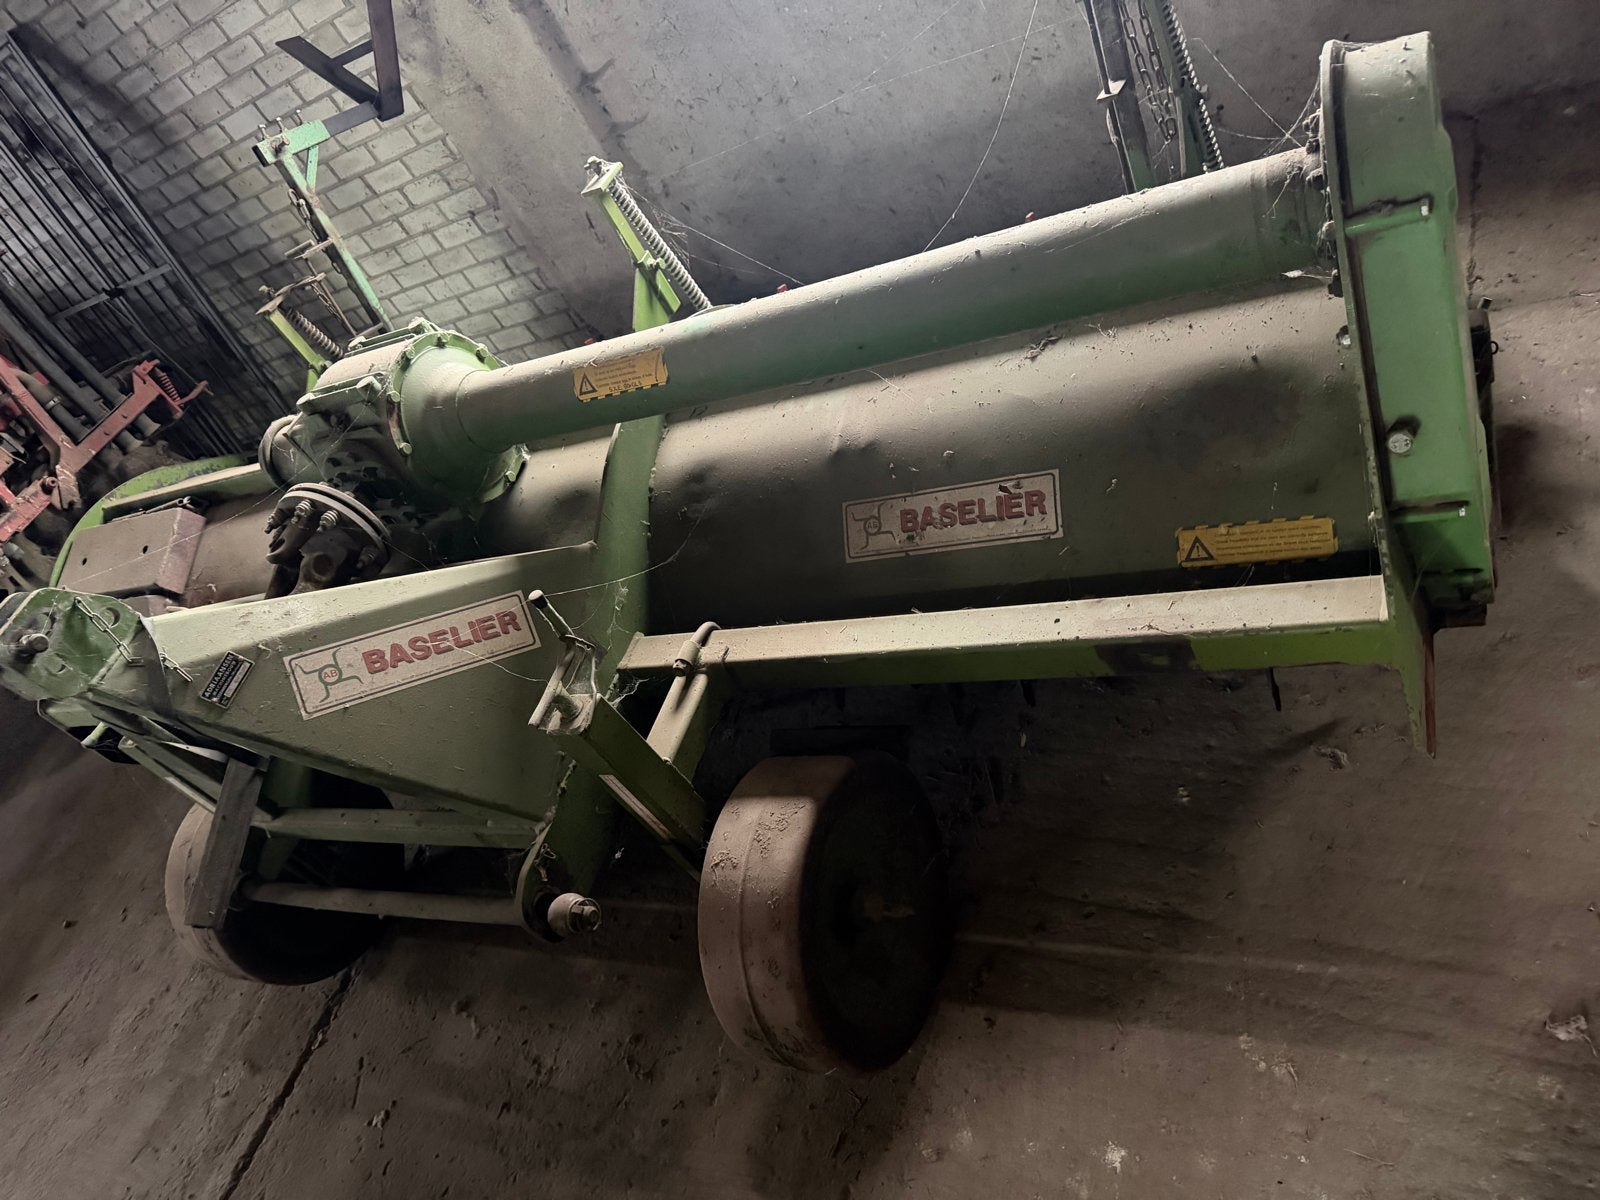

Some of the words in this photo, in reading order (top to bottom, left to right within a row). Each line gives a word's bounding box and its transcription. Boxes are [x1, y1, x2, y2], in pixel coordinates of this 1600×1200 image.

[900, 489, 1048, 534] BASELIER
[361, 610, 522, 675] BASELIER
[204, 654, 234, 698] ADRIAANSEN
[322, 669, 338, 680] AB
